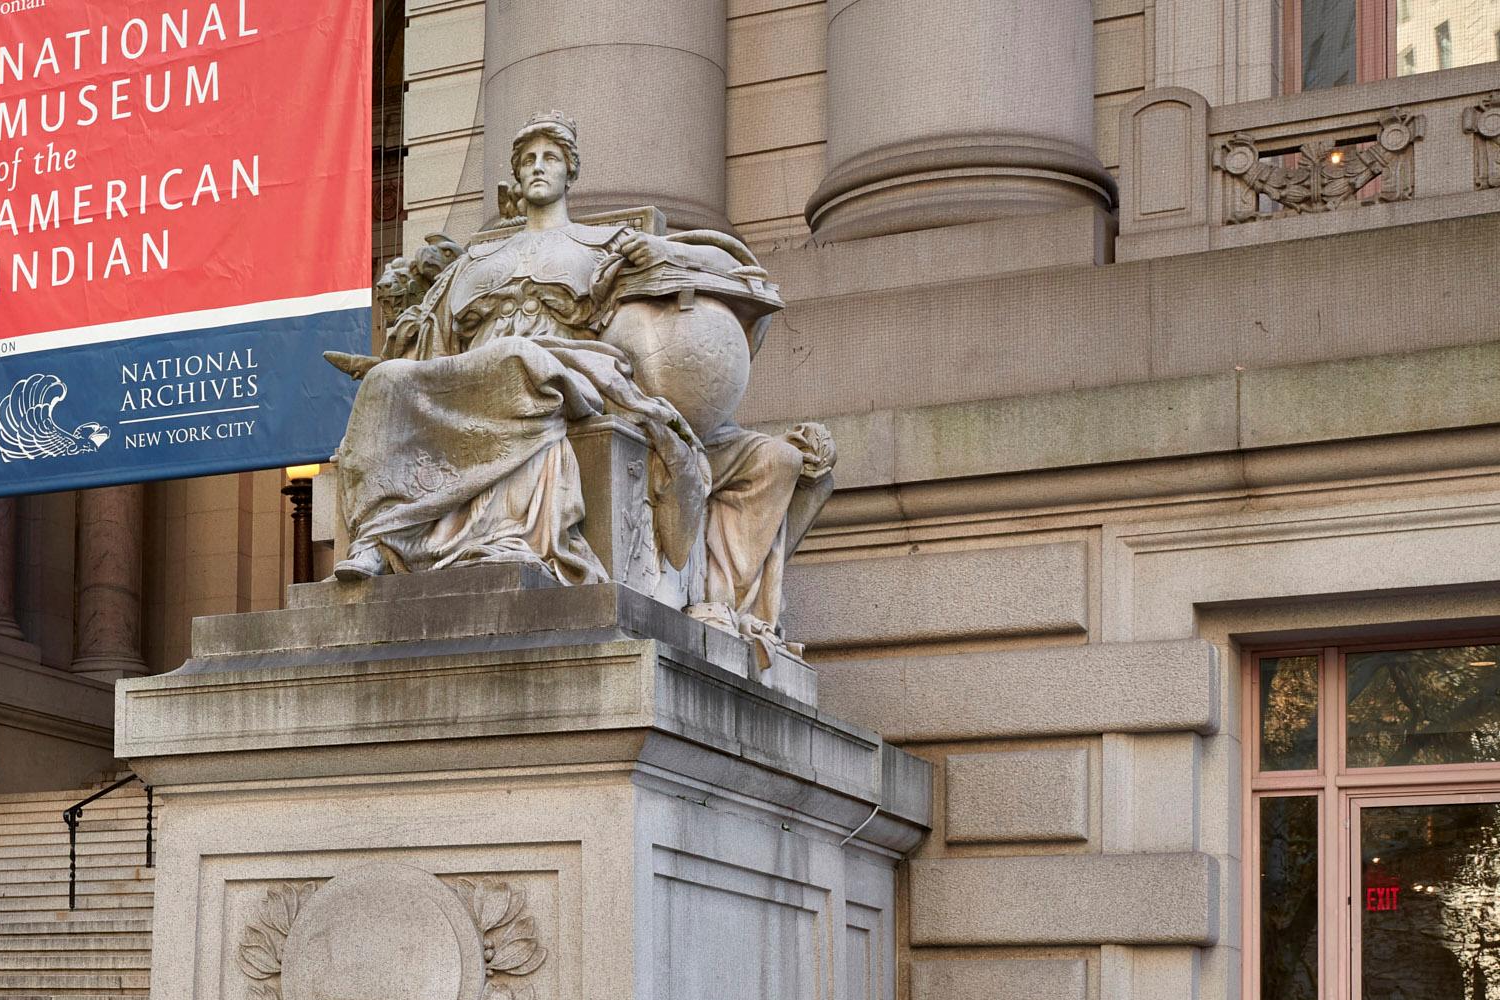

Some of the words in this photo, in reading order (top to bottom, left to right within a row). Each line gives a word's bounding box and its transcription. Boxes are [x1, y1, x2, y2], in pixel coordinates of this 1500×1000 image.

[33, 142, 77, 175] the
[121, 348, 259, 385] NATIONAL
[120, 374, 258, 412] ARCHIVES
[125, 431, 162, 449] NEW
[165, 425, 213, 444] YORK
[216, 420, 256, 439] CITY
[1366, 887, 1400, 911] EXIT
